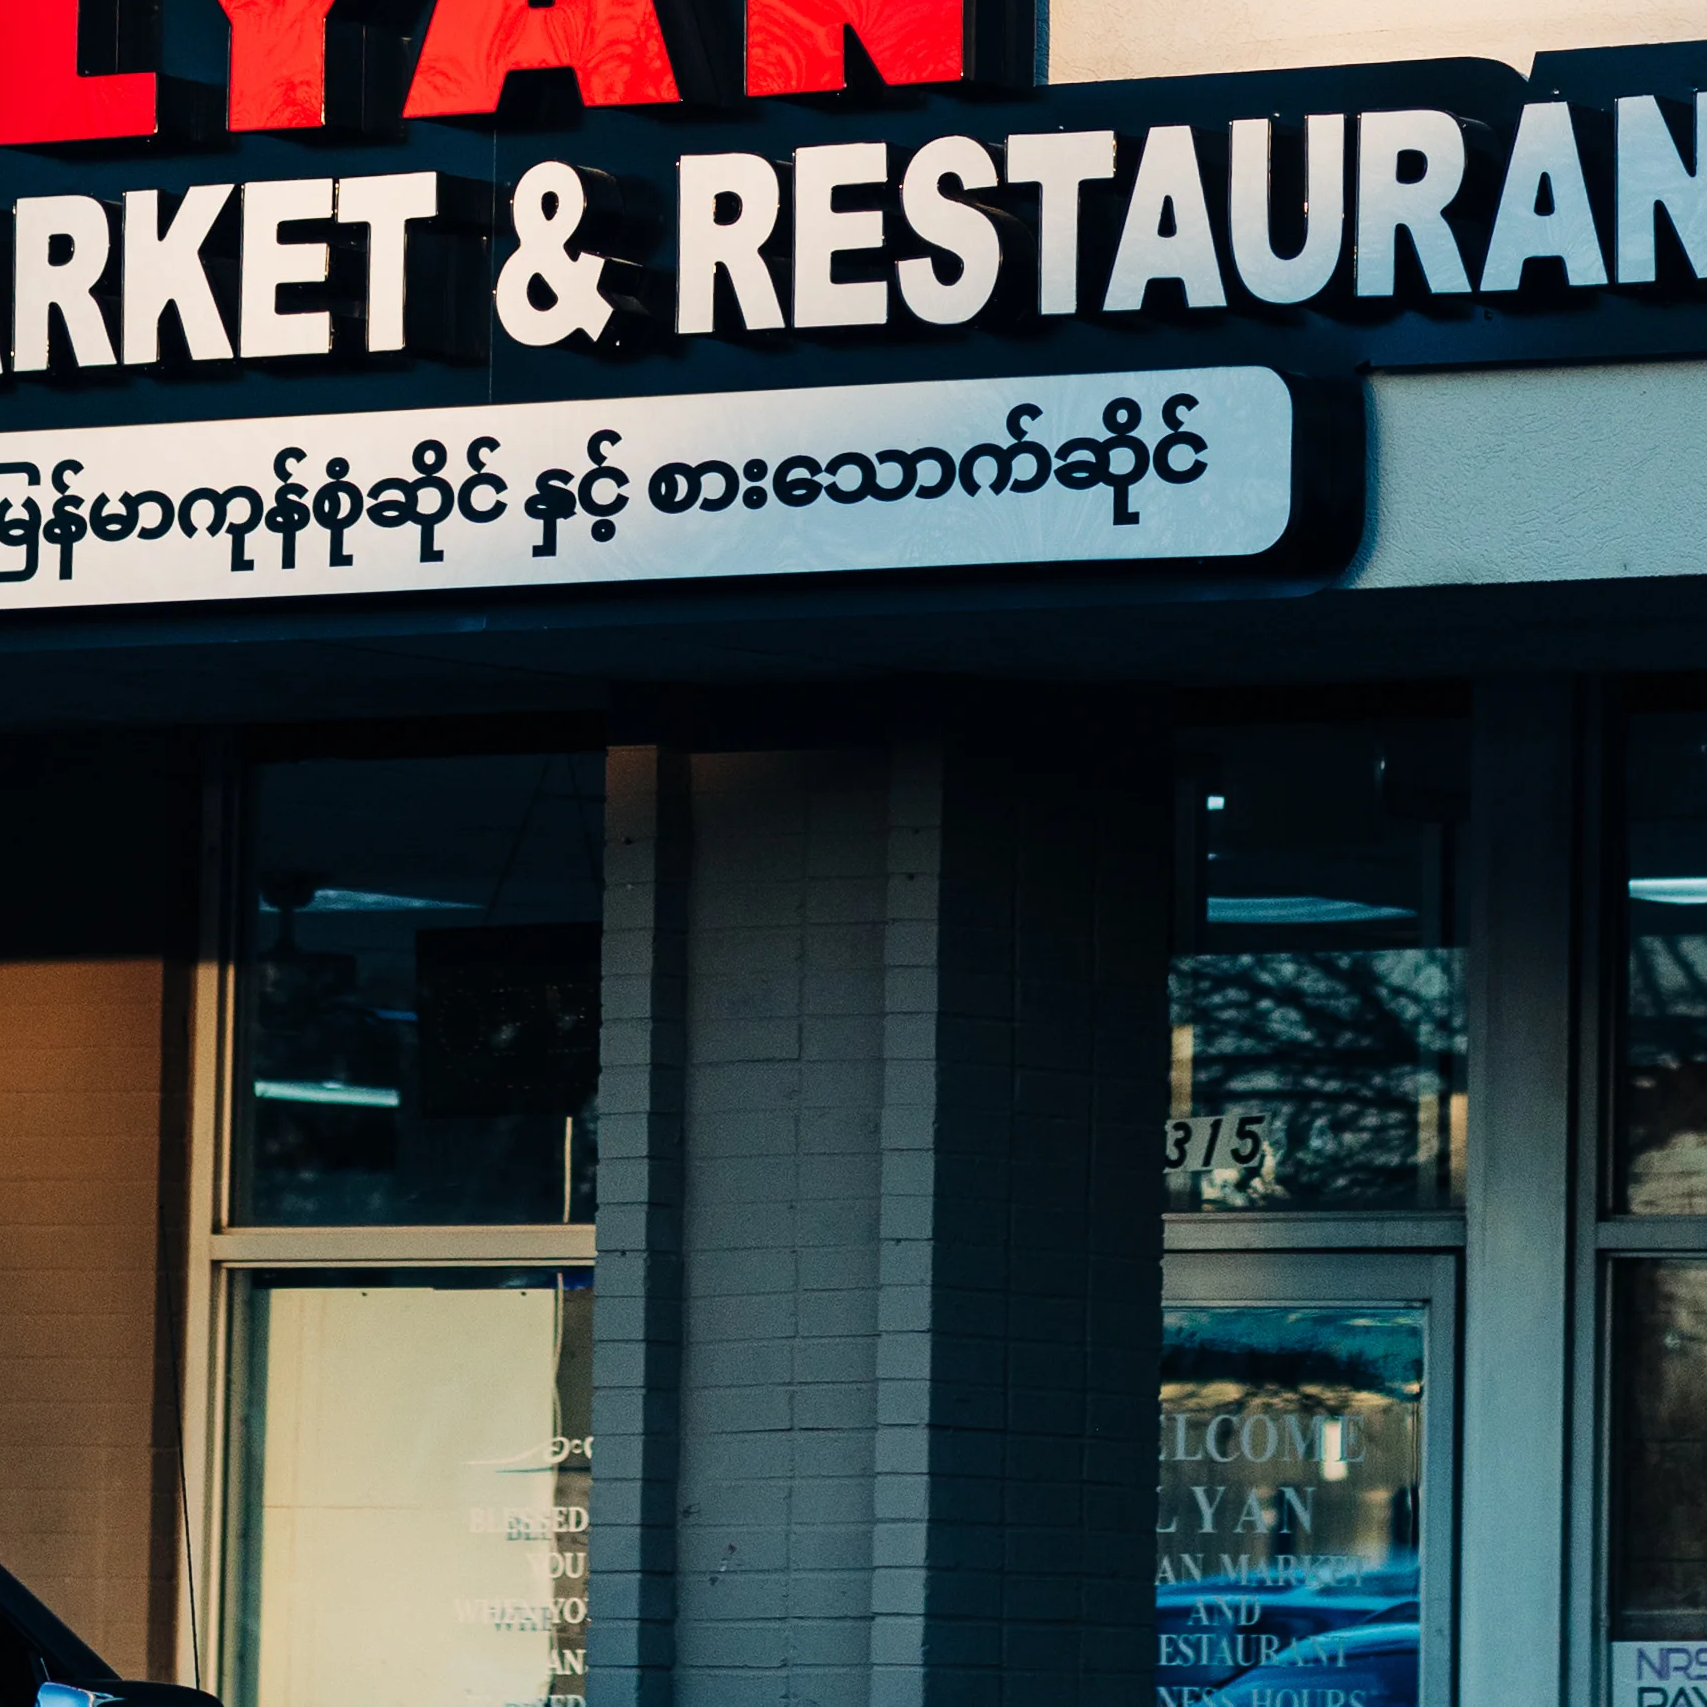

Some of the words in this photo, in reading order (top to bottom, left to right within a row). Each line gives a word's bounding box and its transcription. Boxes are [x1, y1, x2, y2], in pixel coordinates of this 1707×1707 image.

[495, 160, 614, 346] &
[648, 393, 1208, 526] စားသောက်ဆိုင်
[1165, 1115, 1266, 1169] 315
[1159, 1413, 1366, 1463] LCOME
[1187, 1595, 1261, 1626] AND
